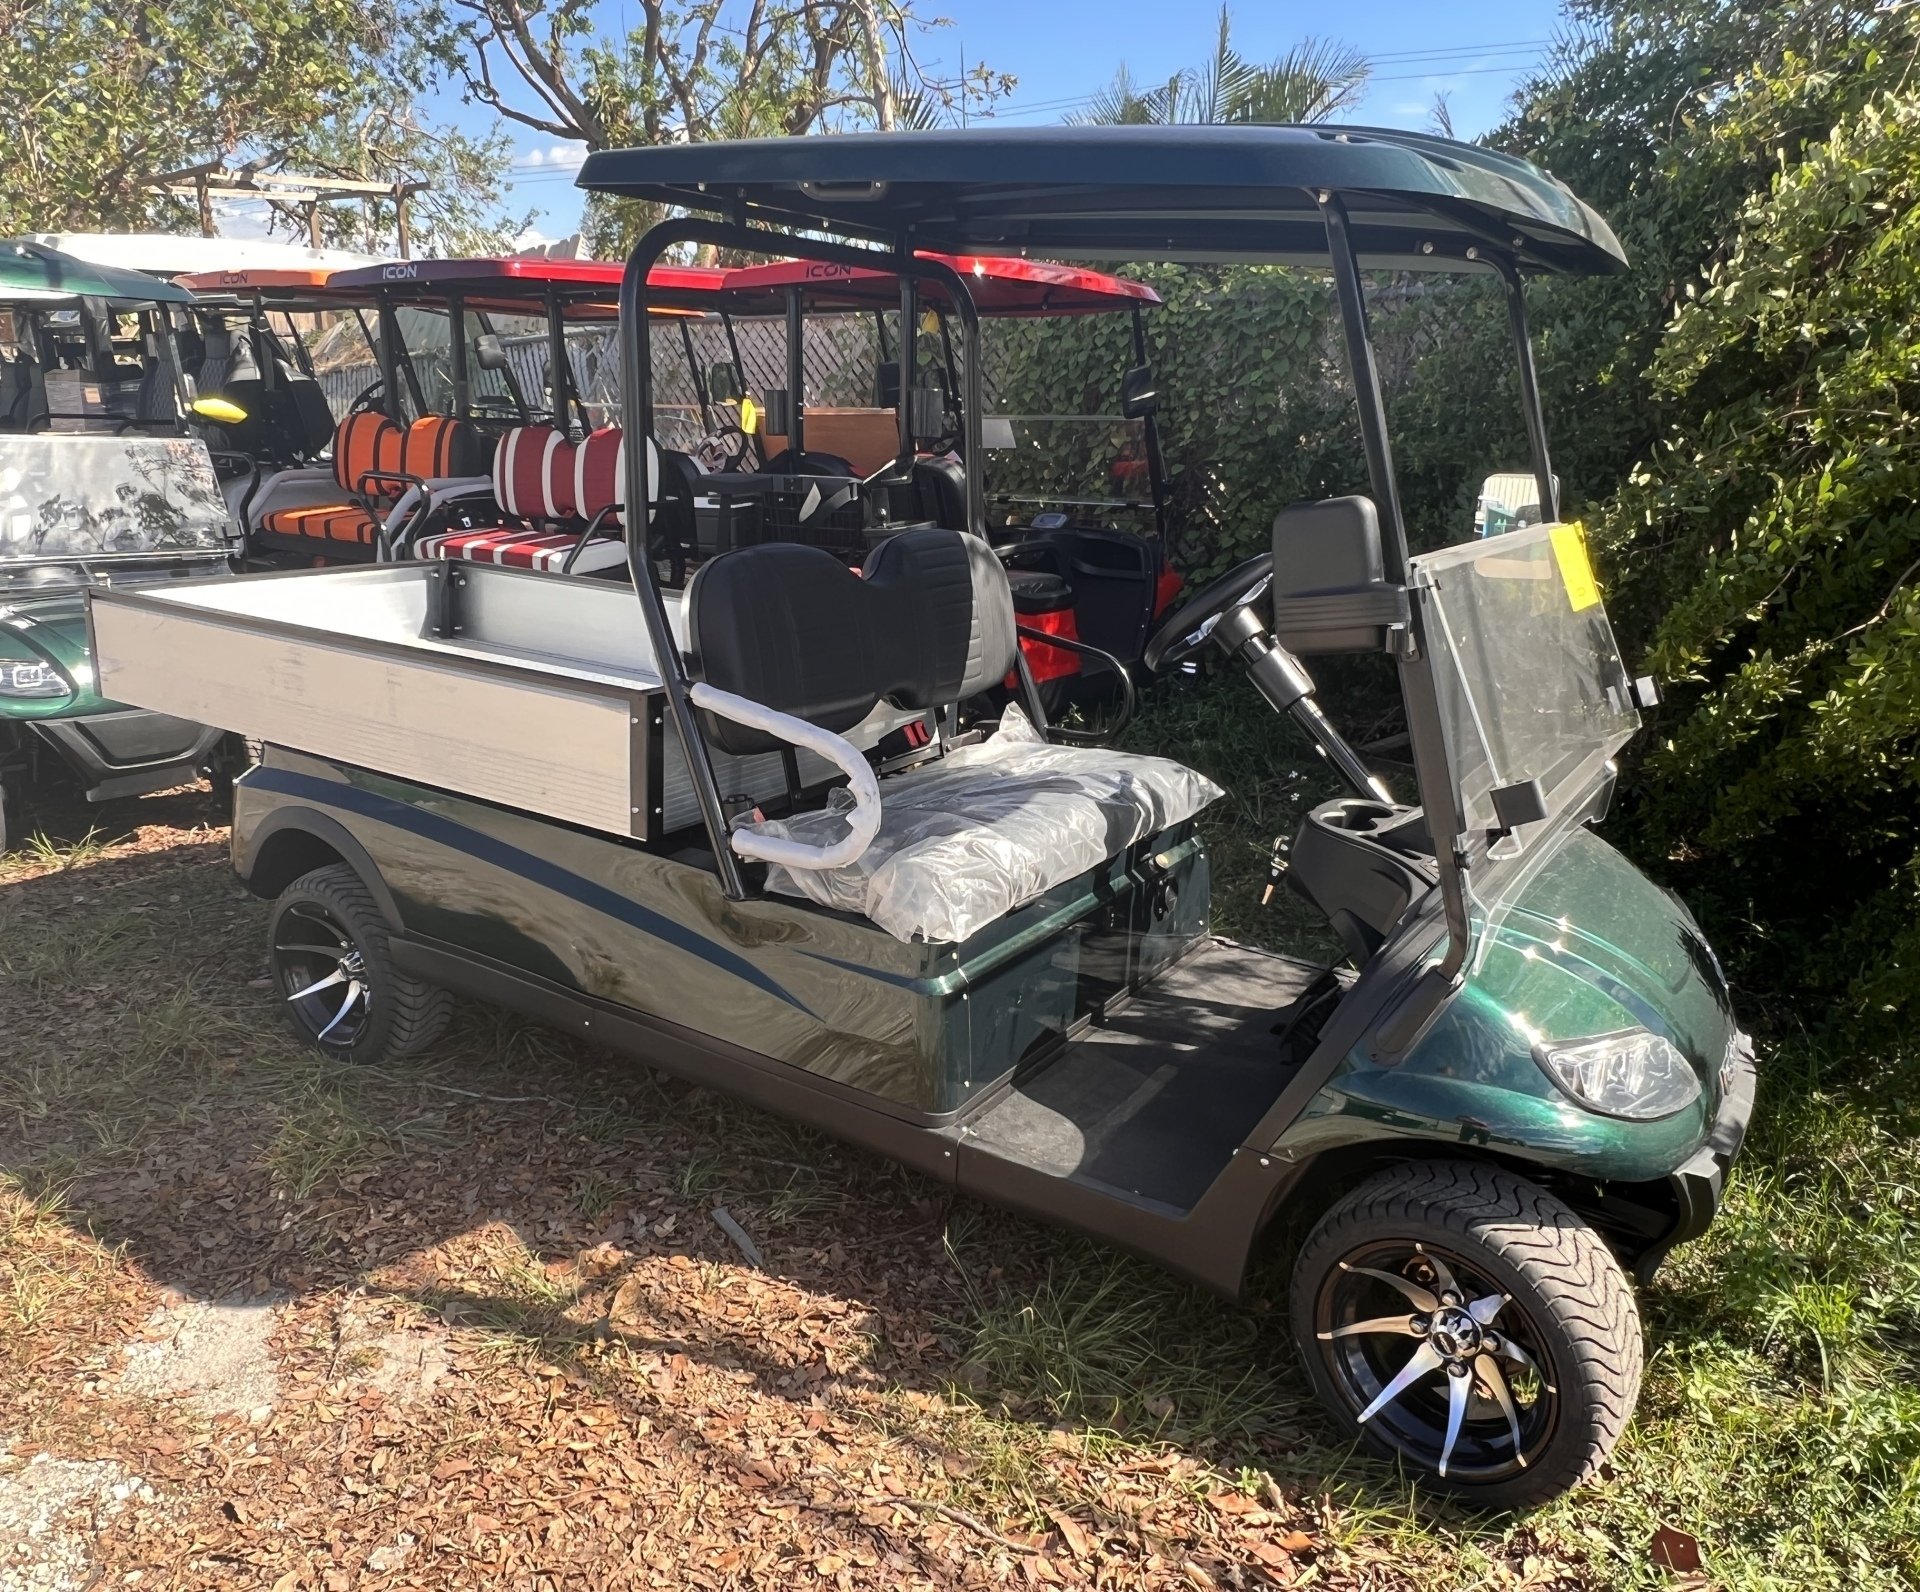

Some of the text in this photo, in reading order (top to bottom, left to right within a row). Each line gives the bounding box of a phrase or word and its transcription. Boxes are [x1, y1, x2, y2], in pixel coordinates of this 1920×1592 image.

[382, 264, 418, 280] ICON
[805, 264, 851, 278] ICON
[219, 272, 248, 285] ICON
